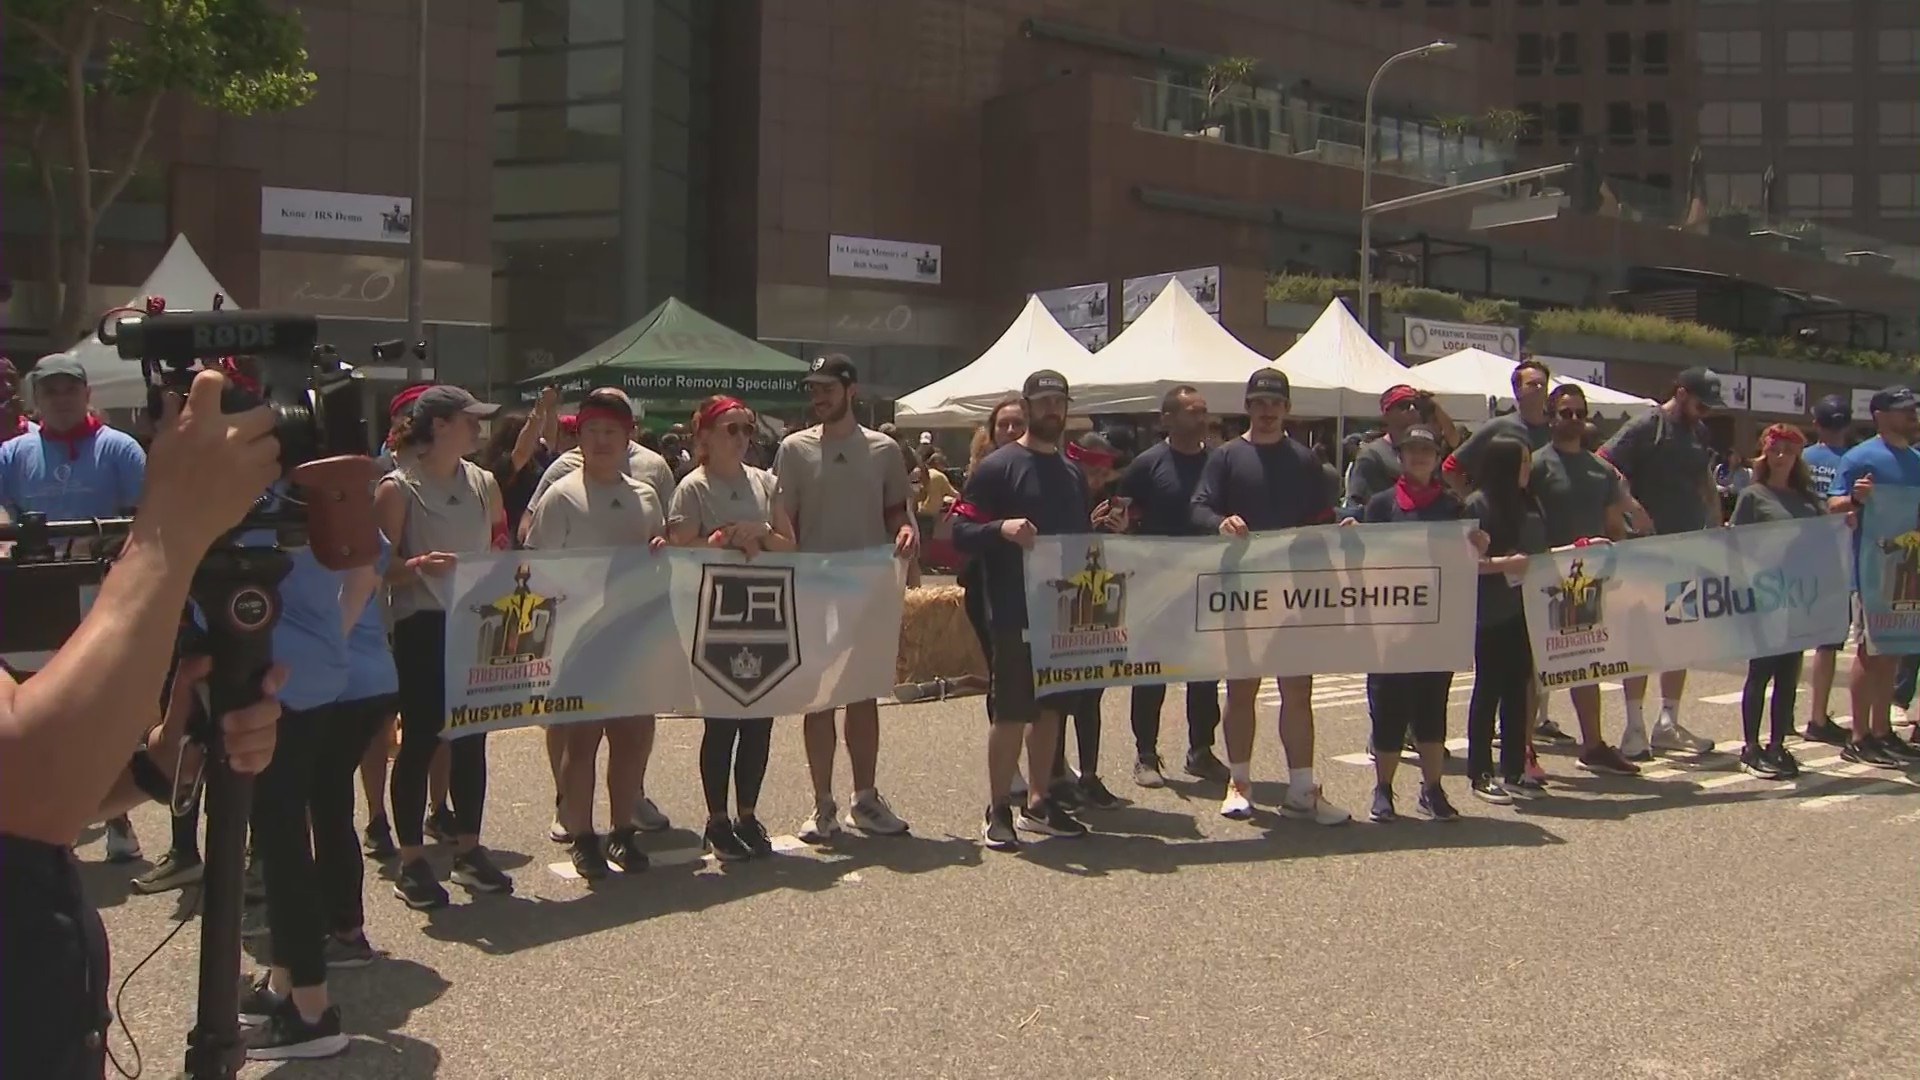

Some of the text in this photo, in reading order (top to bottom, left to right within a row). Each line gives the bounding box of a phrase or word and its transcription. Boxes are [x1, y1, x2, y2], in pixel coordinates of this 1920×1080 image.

[315, 210, 333, 220] IRS
[335, 213, 363, 223] Demo
[1429, 328, 1464, 339] OPERATING
[623, 374, 672, 388] Interior
[676, 375, 733, 389] Removal
[712, 584, 783, 622] LA
[1208, 585, 1429, 613] ONE WILSHIRE
[1701, 567, 1819, 619] BluSky
[1050, 628, 1128, 649] FIREFIGHTERS
[1545, 627, 1609, 652] FIREFIGHTERS
[467, 659, 552, 685] FIREFIGHTERS
